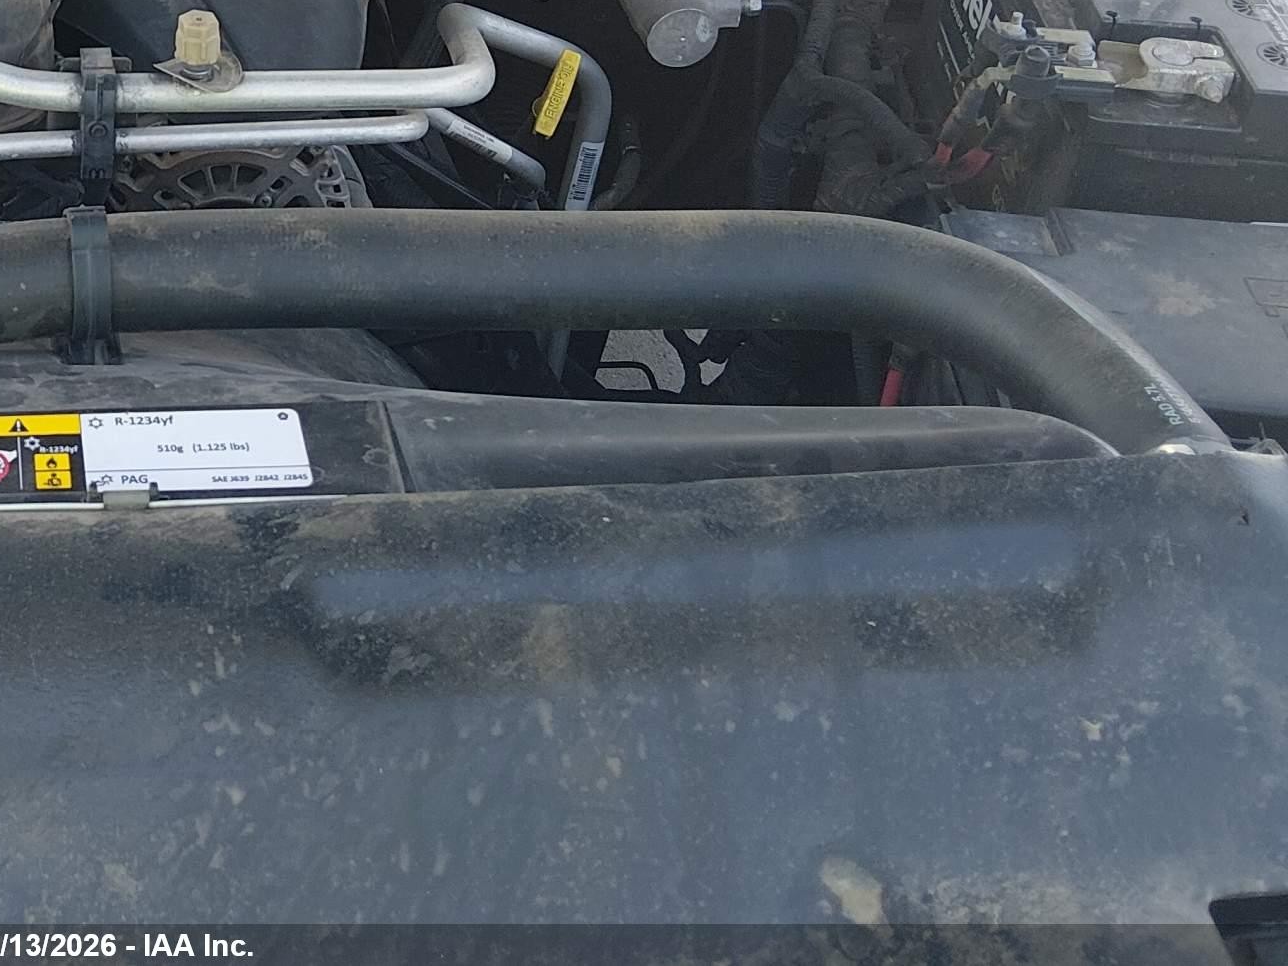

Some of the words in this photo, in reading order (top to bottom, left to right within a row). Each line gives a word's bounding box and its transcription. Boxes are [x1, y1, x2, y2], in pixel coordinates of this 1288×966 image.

[544, 80, 566, 120] ENGINE
[560, 64, 574, 79] OIL
[1158, 403, 1184, 425] RAD
[115, 415, 173, 426] R-1234yf
[39, 445, 78, 454] R-1234yf
[157, 444, 184, 453] 510g
[192, 442, 227, 452] (1.125
[230, 442, 250, 452] lbs)
[121, 474, 149, 484] PAG
[212, 475, 228, 483] SAE
